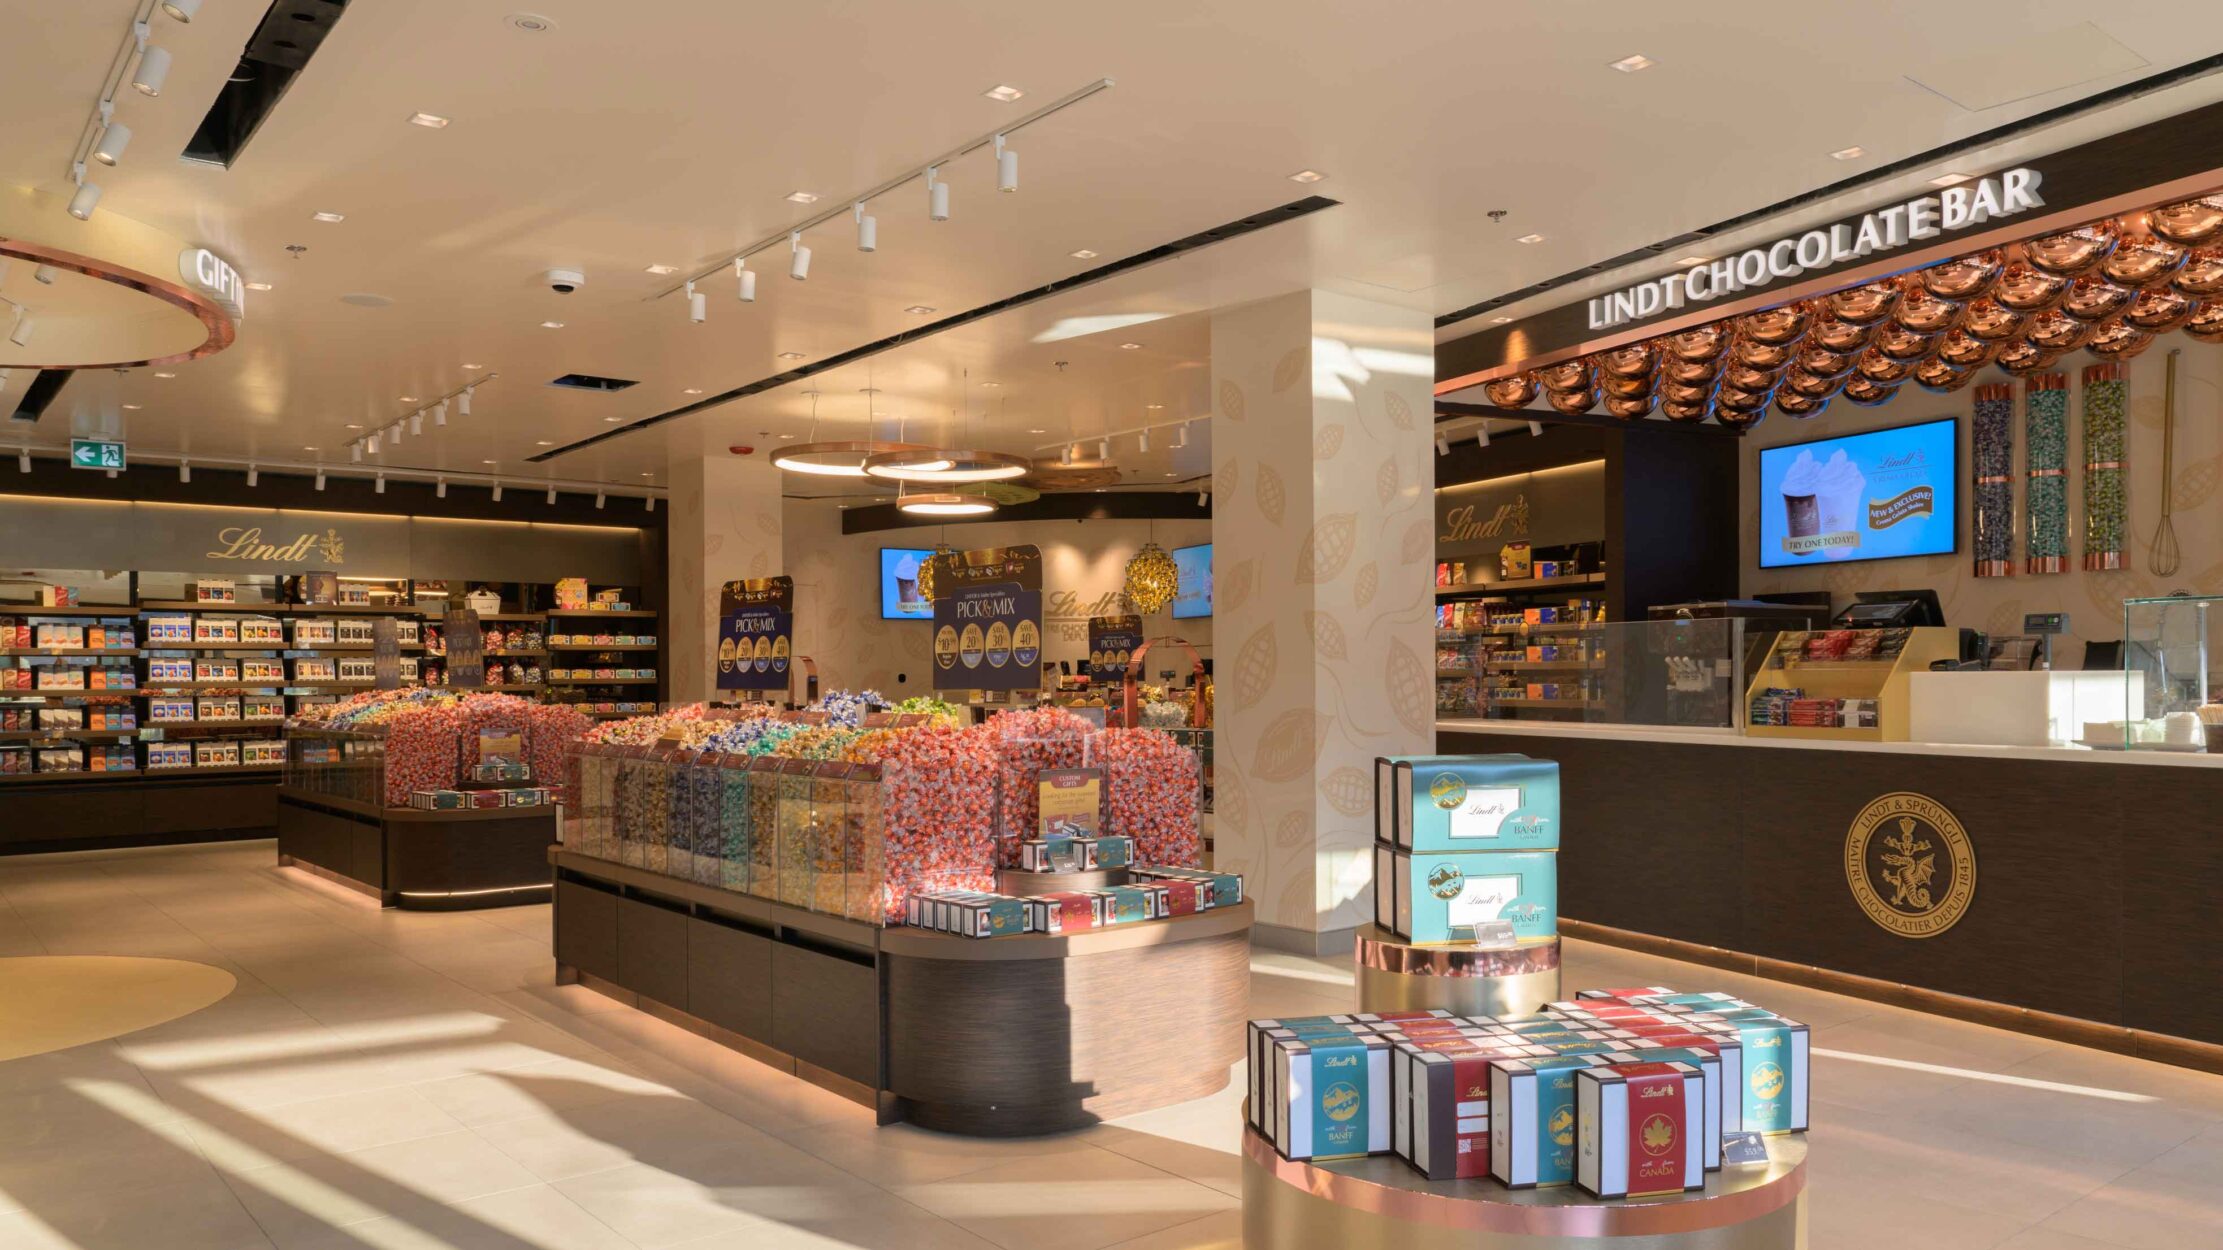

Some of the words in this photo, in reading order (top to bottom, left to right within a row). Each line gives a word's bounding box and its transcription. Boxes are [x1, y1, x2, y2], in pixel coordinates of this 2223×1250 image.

[1589, 274, 1686, 330] LINDT
[1684, 197, 1940, 301] CHOCOLATE
[1940, 168, 2045, 230] BAR
[1870, 507, 1889, 519] NEW
[1887, 505, 1894, 514] &
[1439, 504, 1512, 542] Lindt
[206, 527, 319, 562] Lindt
[1789, 540, 1803, 550] TRY
[1804, 537, 1823, 548] ONE
[1823, 535, 1855, 546] TODAY!
[1043, 590, 1117, 617] Lindt
[1468, 805, 1497, 816] Lindt
[1860, 801, 1891, 829] LINDT
[1894, 799, 1902, 810] &
[1906, 799, 1962, 845] SPRÜNGLI
[1514, 825, 1544, 835] BANFF
[1467, 895, 1496, 905] Lindt
[1859, 886, 1932, 932] CHOCOLATIER
[1933, 891, 1966, 926] DEPUIS
[1959, 857, 1969, 886] 1845
[1511, 913, 1542, 923] BANFF
[1324, 1055, 1352, 1068] Lindt
[1640, 1087, 1667, 1098] Lindt
[1328, 1132, 1354, 1141] BANFF
[1639, 1167, 1675, 1177] CANADA
